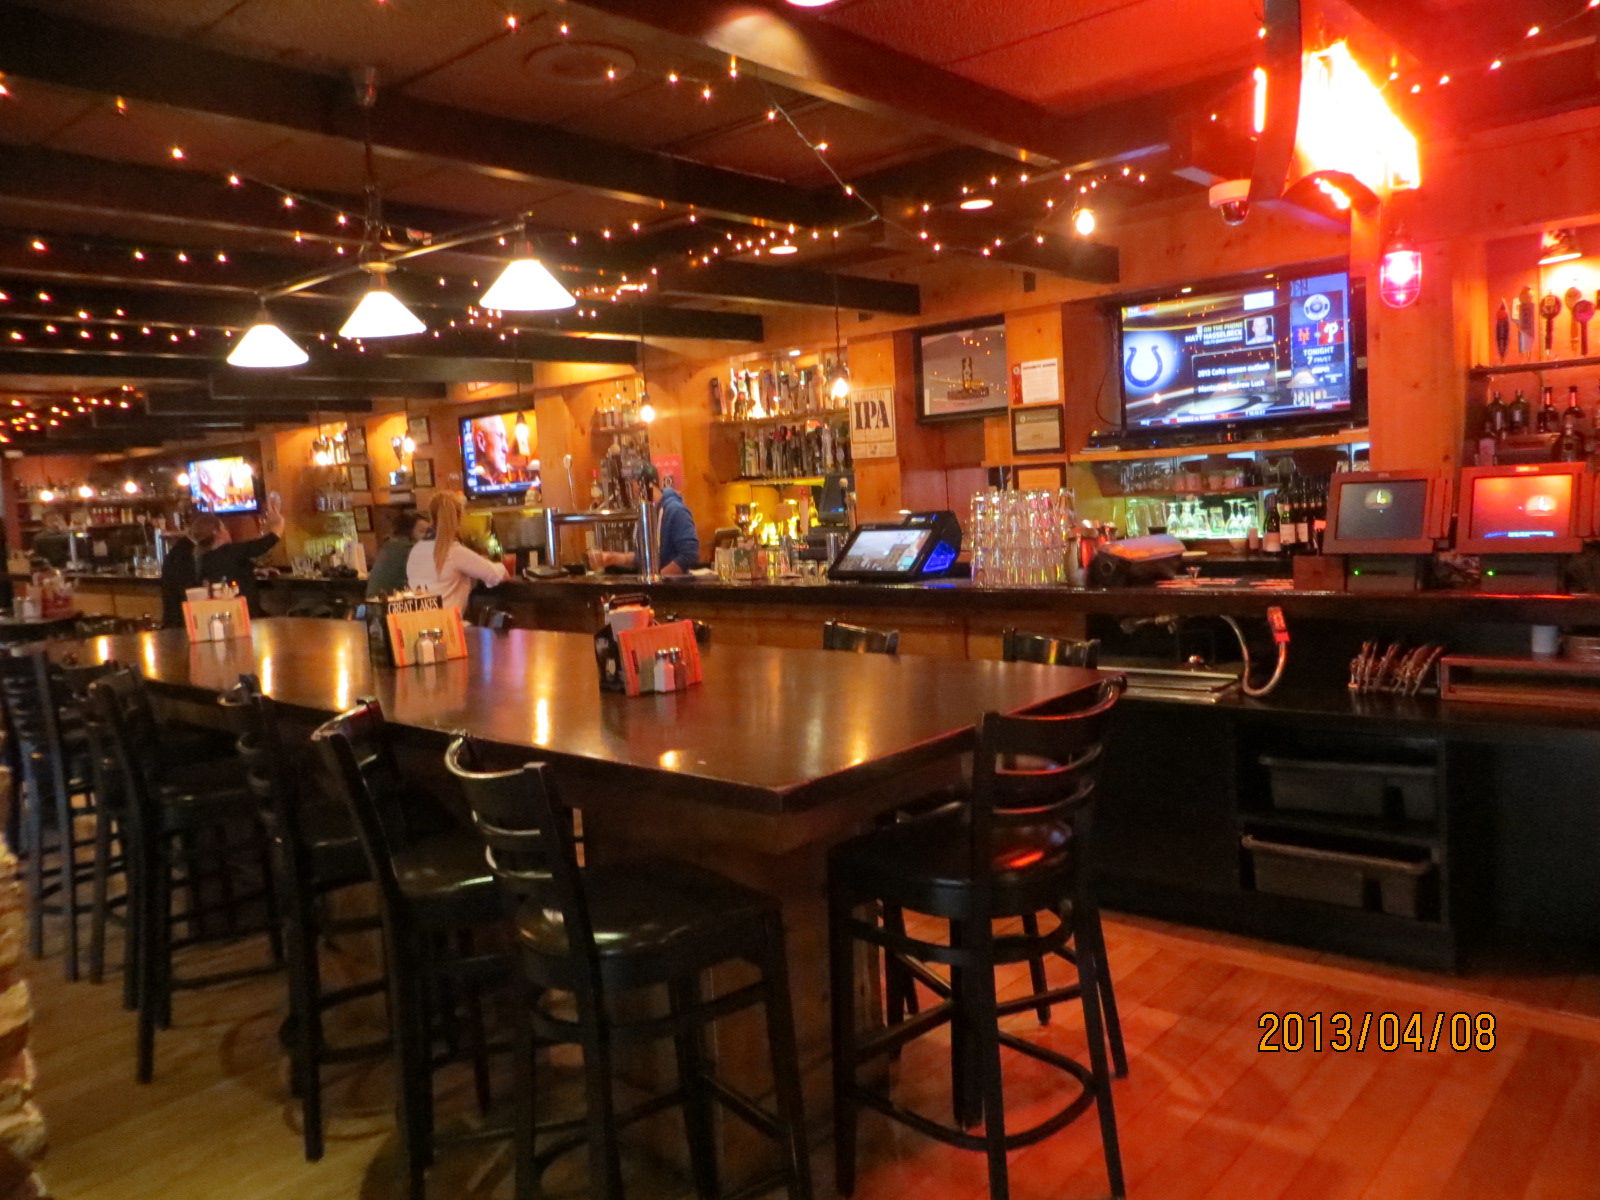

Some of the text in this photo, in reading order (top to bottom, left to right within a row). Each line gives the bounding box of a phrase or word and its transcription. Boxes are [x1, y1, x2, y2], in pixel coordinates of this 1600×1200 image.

[1224, 321, 1244, 330] PHONE
[1185, 328, 1243, 343] MATT HASSELBECK
[1303, 345, 1334, 357] TONIGHT
[1306, 356, 1313, 365] 7
[1197, 361, 1271, 378] 2013 Colts season outlook
[1197, 377, 1265, 393] Mentoring Andrew Luck
[853, 400, 890, 430] IPA
[388, 598, 439, 615] GREAT LAKES
